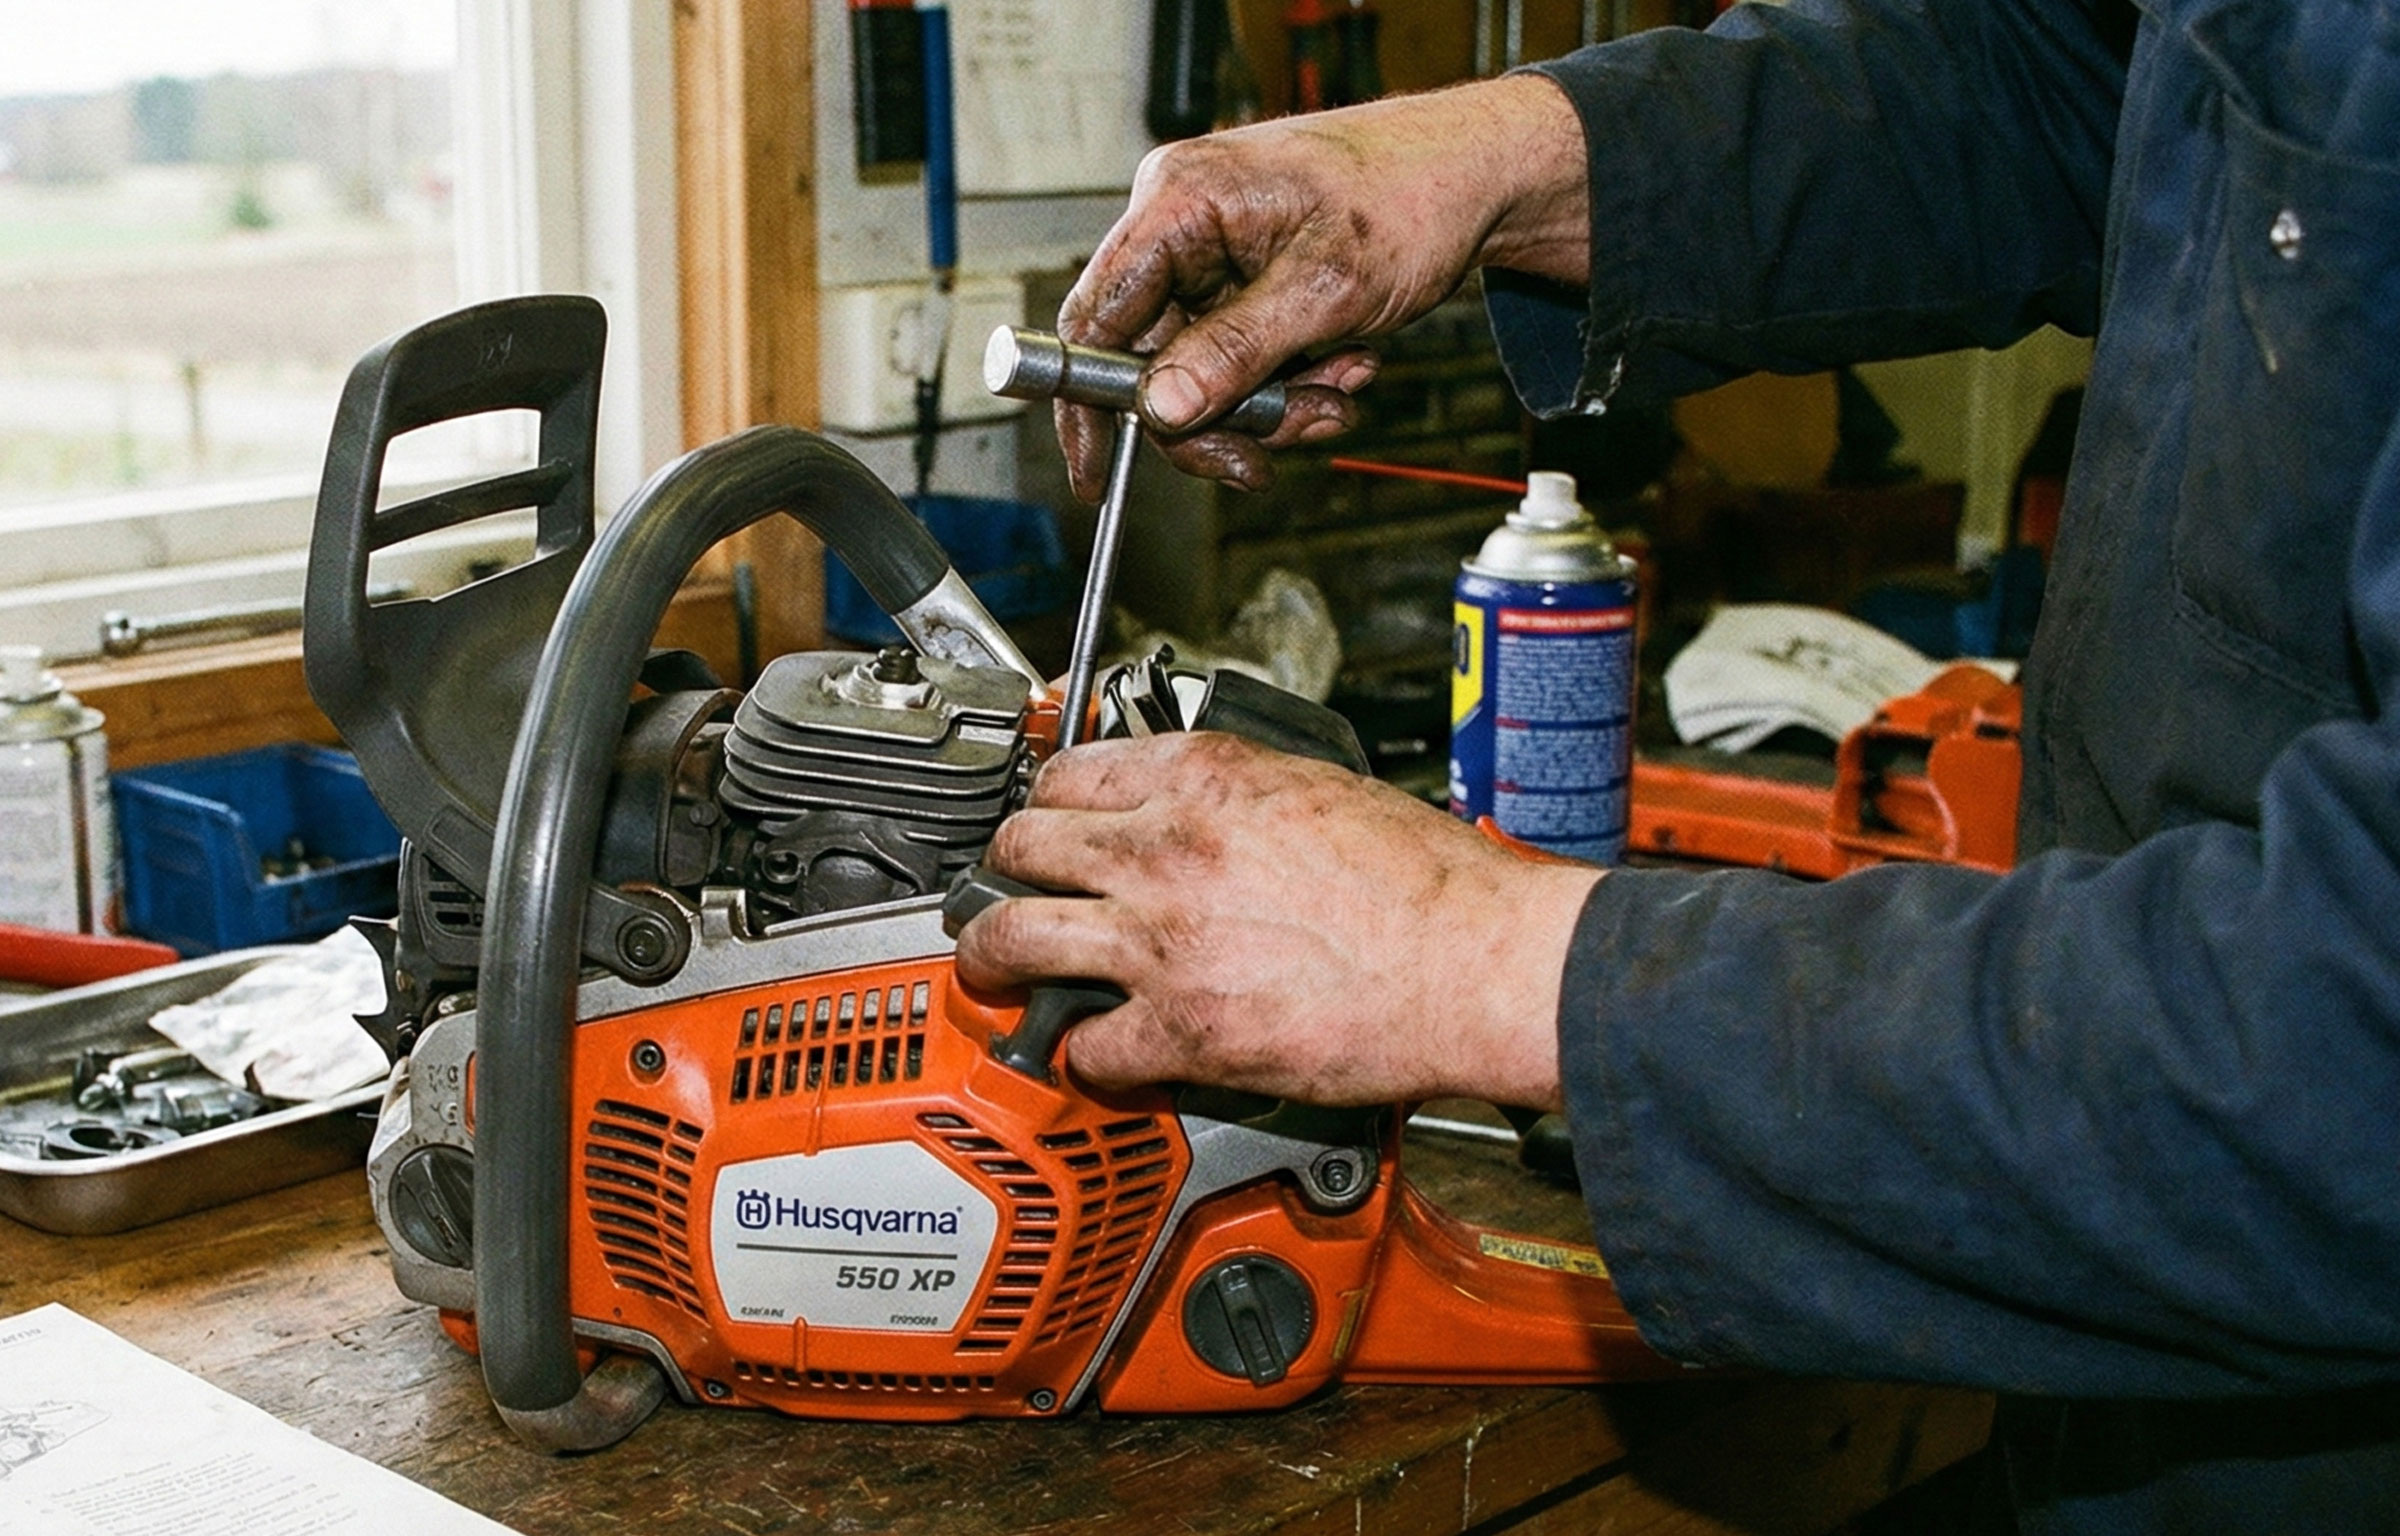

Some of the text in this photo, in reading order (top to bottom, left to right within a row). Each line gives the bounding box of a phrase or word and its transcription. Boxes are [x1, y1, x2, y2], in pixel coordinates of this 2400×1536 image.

[776, 1197, 957, 1236] Husqvarna
[836, 1265, 956, 1291] 550 XP
